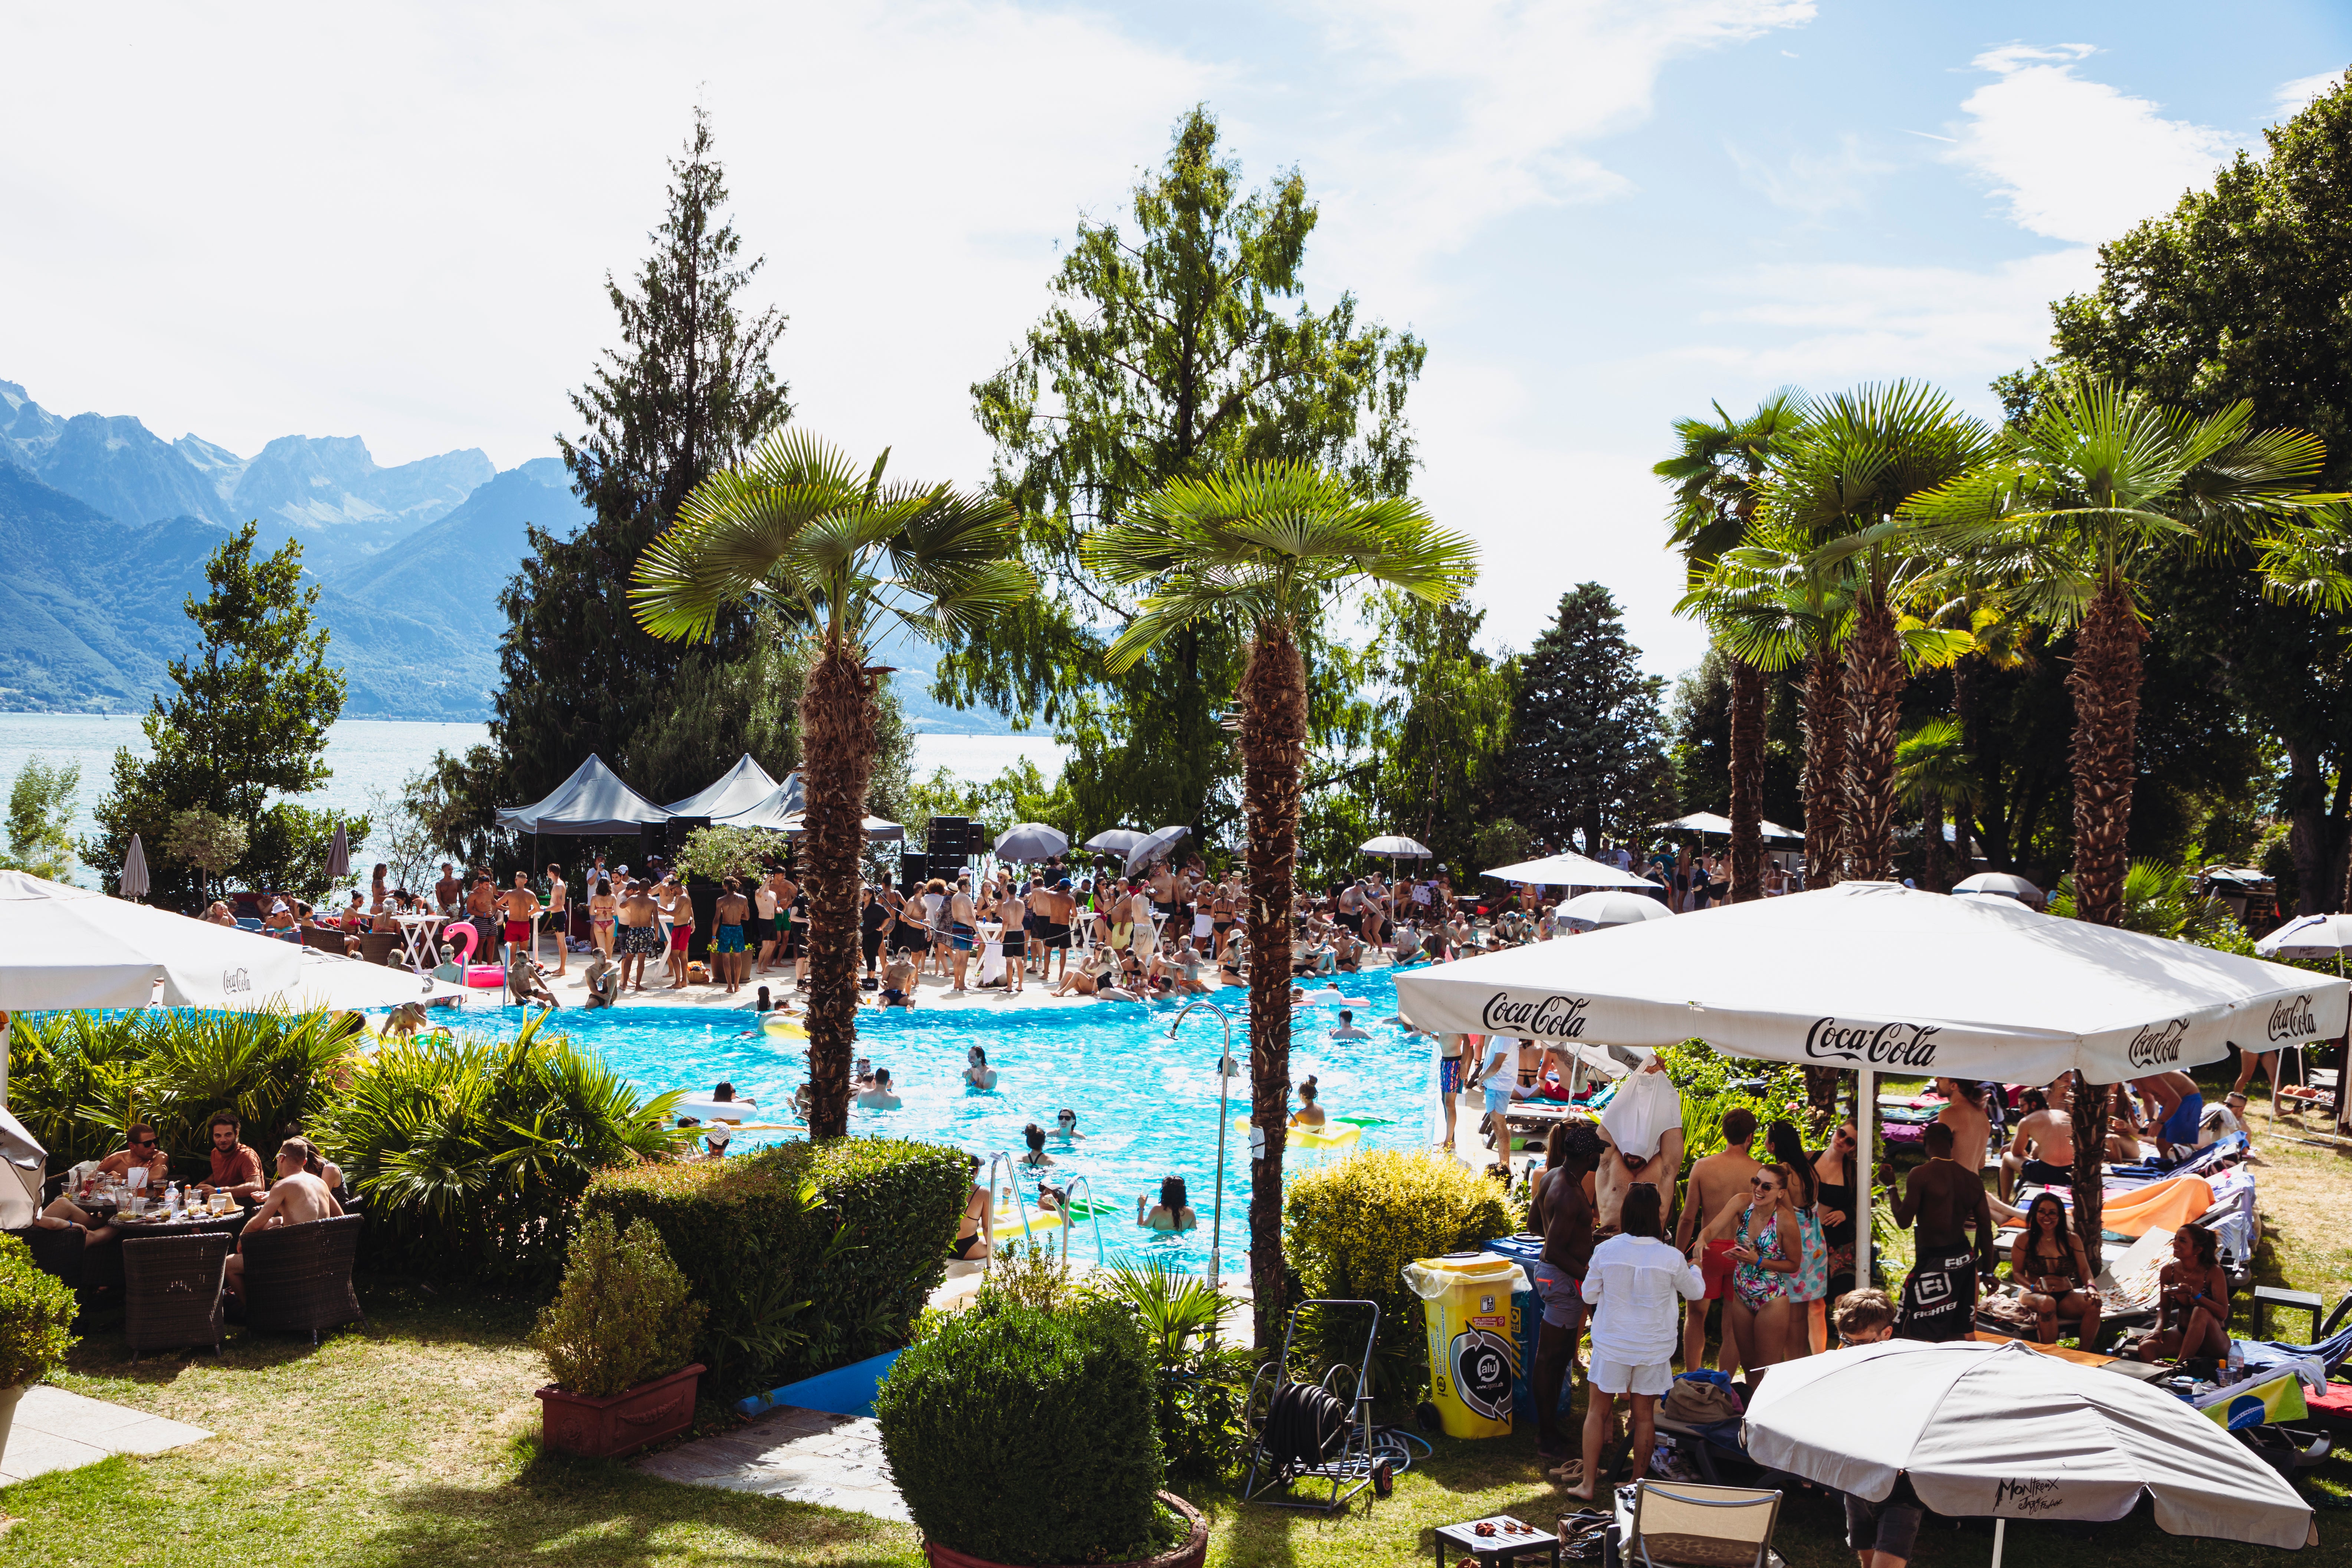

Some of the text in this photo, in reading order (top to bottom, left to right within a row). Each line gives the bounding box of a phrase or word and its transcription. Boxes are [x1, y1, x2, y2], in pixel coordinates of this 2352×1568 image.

[223, 968, 251, 995] Coca-Cola
[1482, 992, 1591, 1038] Coca-Cola
[2268, 994, 2317, 1042] Coca-Cola
[1805, 1017, 1942, 1067] Coca-Cola
[2128, 1018, 2190, 1069] Coca-Cola
[1476, 1381, 1503, 1390] www.igora.ch
[1482, 1362, 1496, 1374] alu
[2018, 1495, 2043, 1515] Jazz
